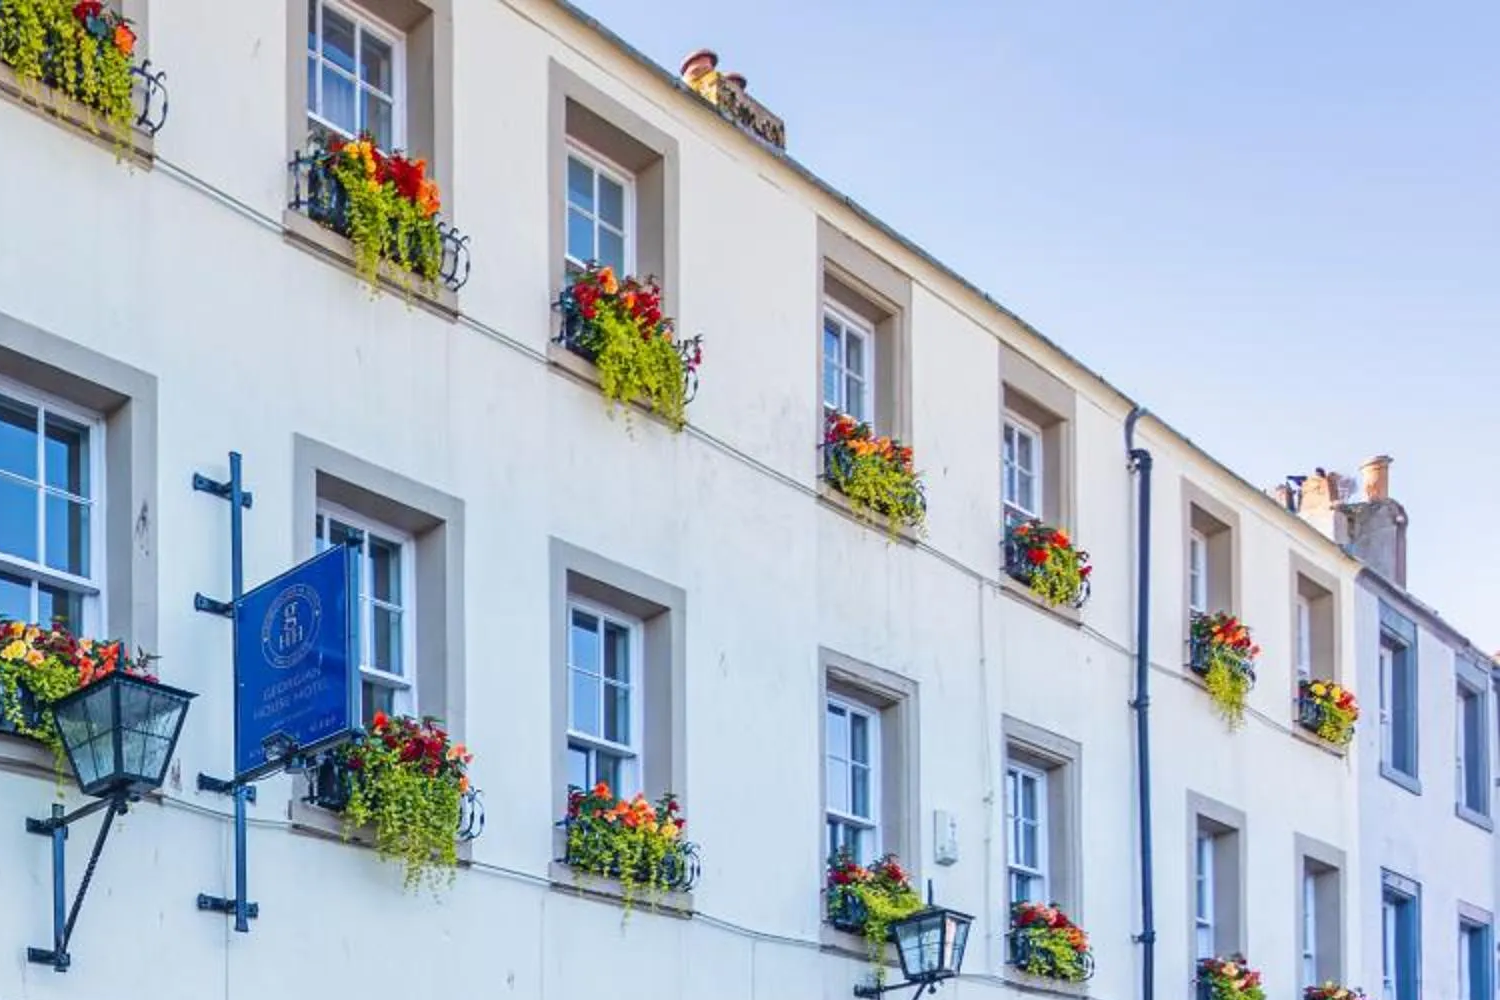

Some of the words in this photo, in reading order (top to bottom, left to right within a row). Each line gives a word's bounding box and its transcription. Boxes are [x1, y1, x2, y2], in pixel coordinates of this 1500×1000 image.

[253, 695, 291, 721] HOUSE
[294, 677, 331, 703] HOTEL
[262, 667, 322, 702] GEORGIAN
